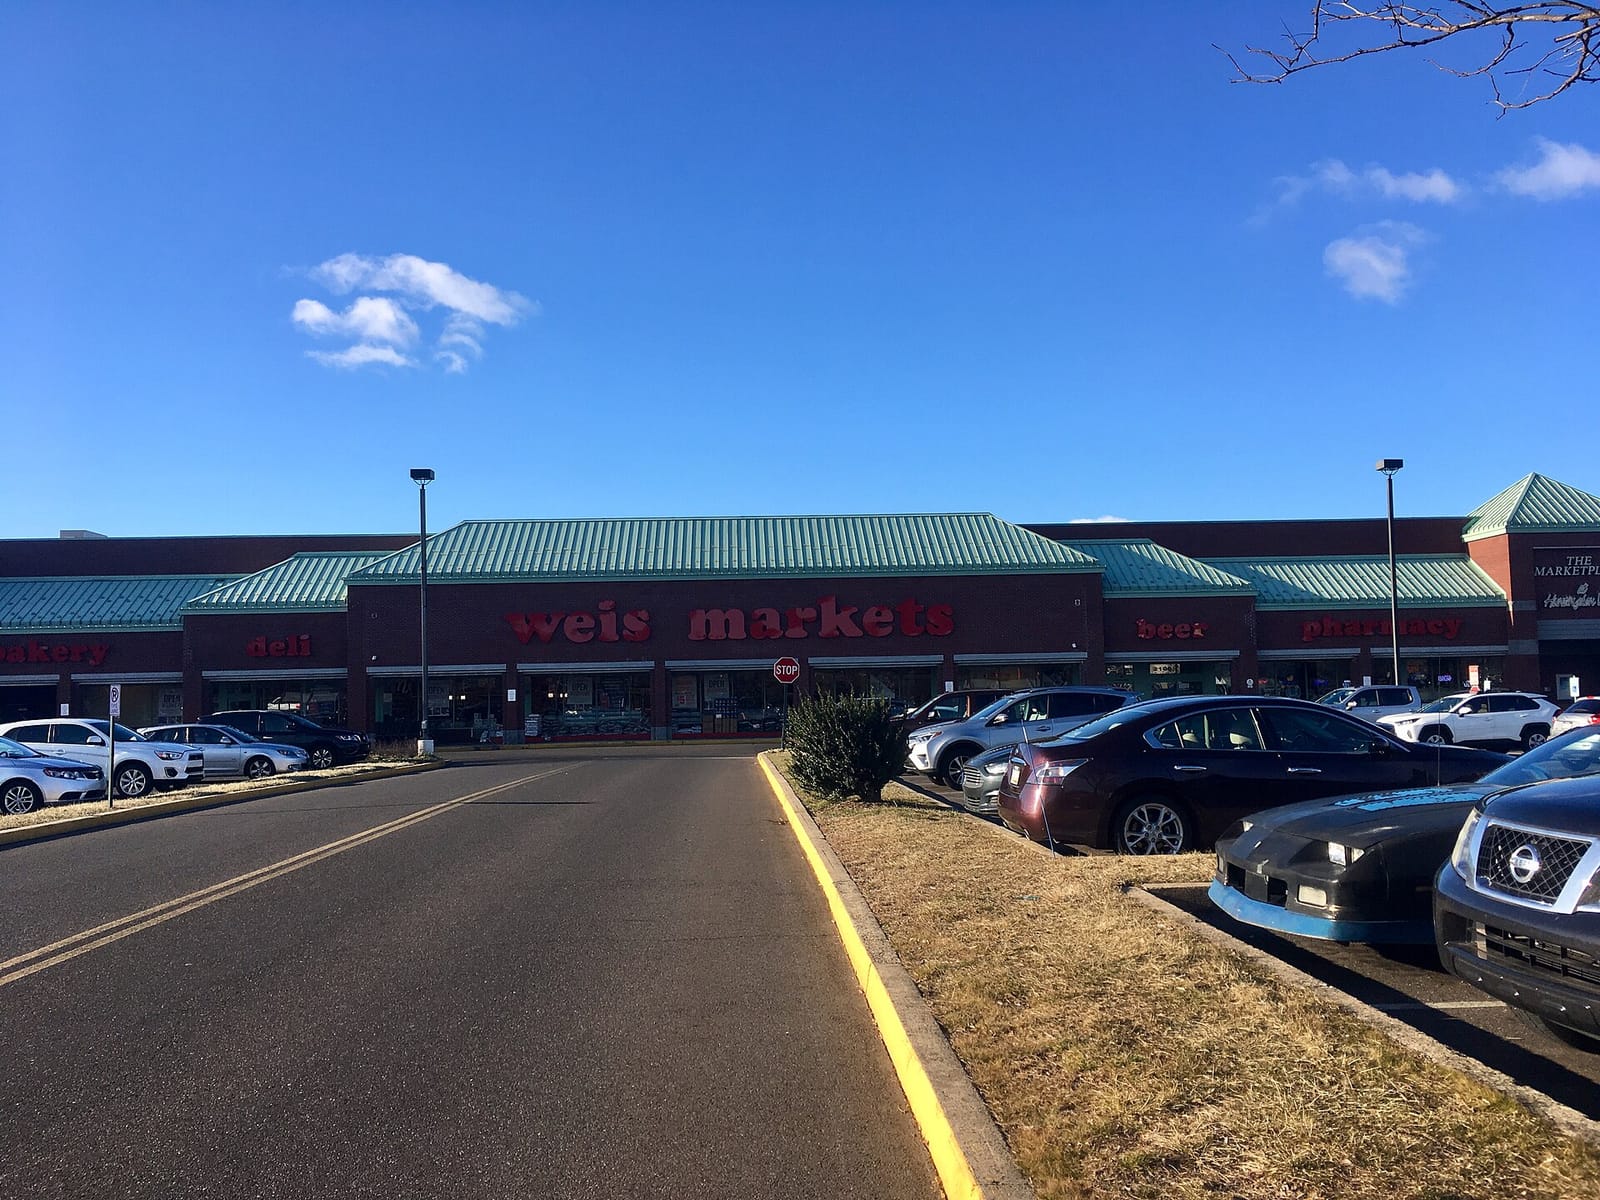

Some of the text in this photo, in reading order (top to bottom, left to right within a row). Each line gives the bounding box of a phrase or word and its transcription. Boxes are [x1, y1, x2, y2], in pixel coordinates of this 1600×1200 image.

[1566, 556, 1593, 566] THE
[505, 595, 955, 645] weis markets
[1136, 618, 1208, 640] beer
[1300, 616, 1464, 642] pharmacy
[247, 634, 311, 656] deli
[775, 664, 799, 676] STOP
